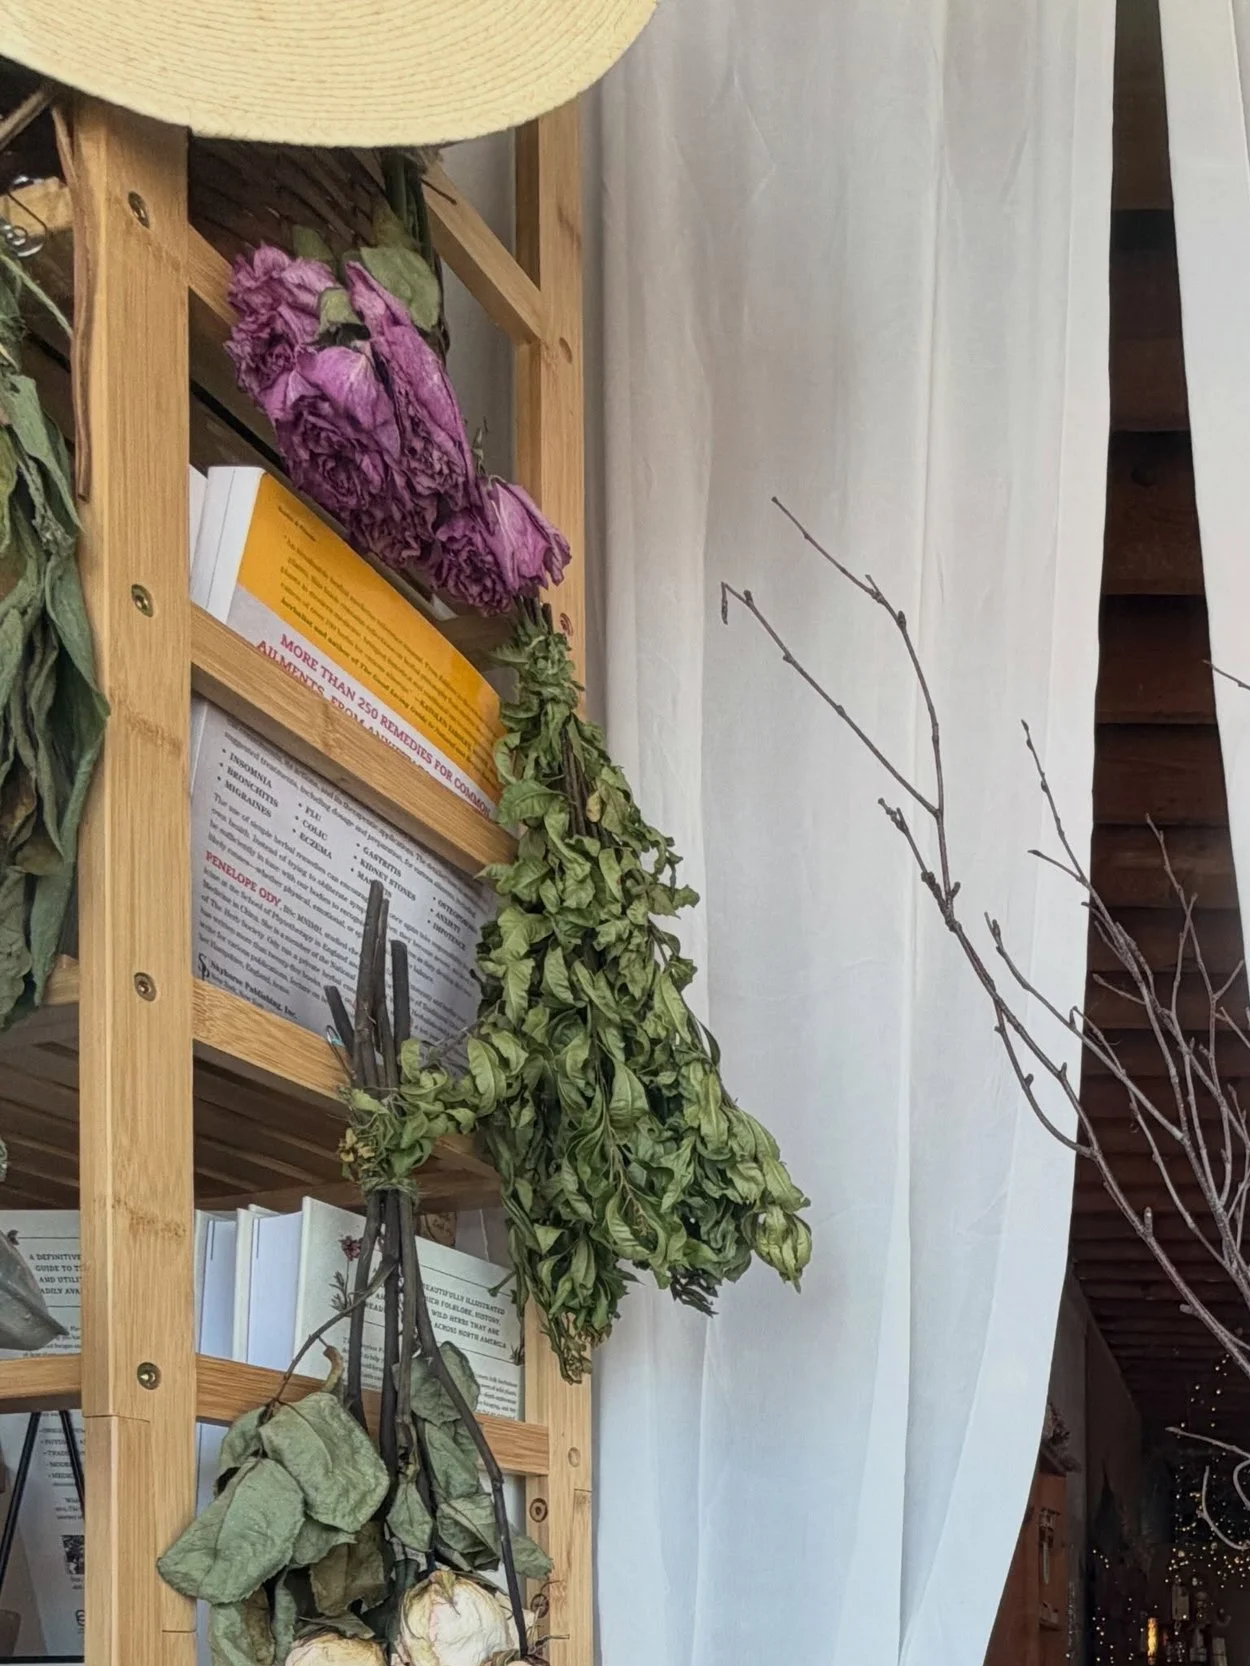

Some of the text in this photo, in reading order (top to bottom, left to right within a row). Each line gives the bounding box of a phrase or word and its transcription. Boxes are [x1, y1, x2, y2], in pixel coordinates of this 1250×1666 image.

[280, 632, 318, 673] MORE
[319, 664, 355, 703] THAN
[358, 696, 377, 720] 250
[379, 713, 432, 765] REMEDIES
[433, 758, 453, 783] FOR
[227, 764, 278, 808] BRONCHITIS
[229, 750, 272, 789] INSOMNIA
[224, 778, 271, 818] MIGRAINES
[305, 805, 321, 823] FLU
[214, 791, 227, 808] The
[241, 812, 250, 823] of
[274, 834, 295, 855] herbal
[302, 817, 327, 842] COLIC
[299, 830, 332, 860] ECZEMA
[362, 843, 401, 878] GASTRITIS
[205, 850, 256, 892] PENELOPE
[279, 852, 286, 863] of
[308, 871, 315, 882] to
[360, 855, 416, 902] KIDNEY STONES
[432, 1309, 448, 1320] WILD
[471, 1320, 486, 1331] THAT
[434, 1322, 457, 1335] ACROSS
[459, 1329, 479, 1341] NORTH
